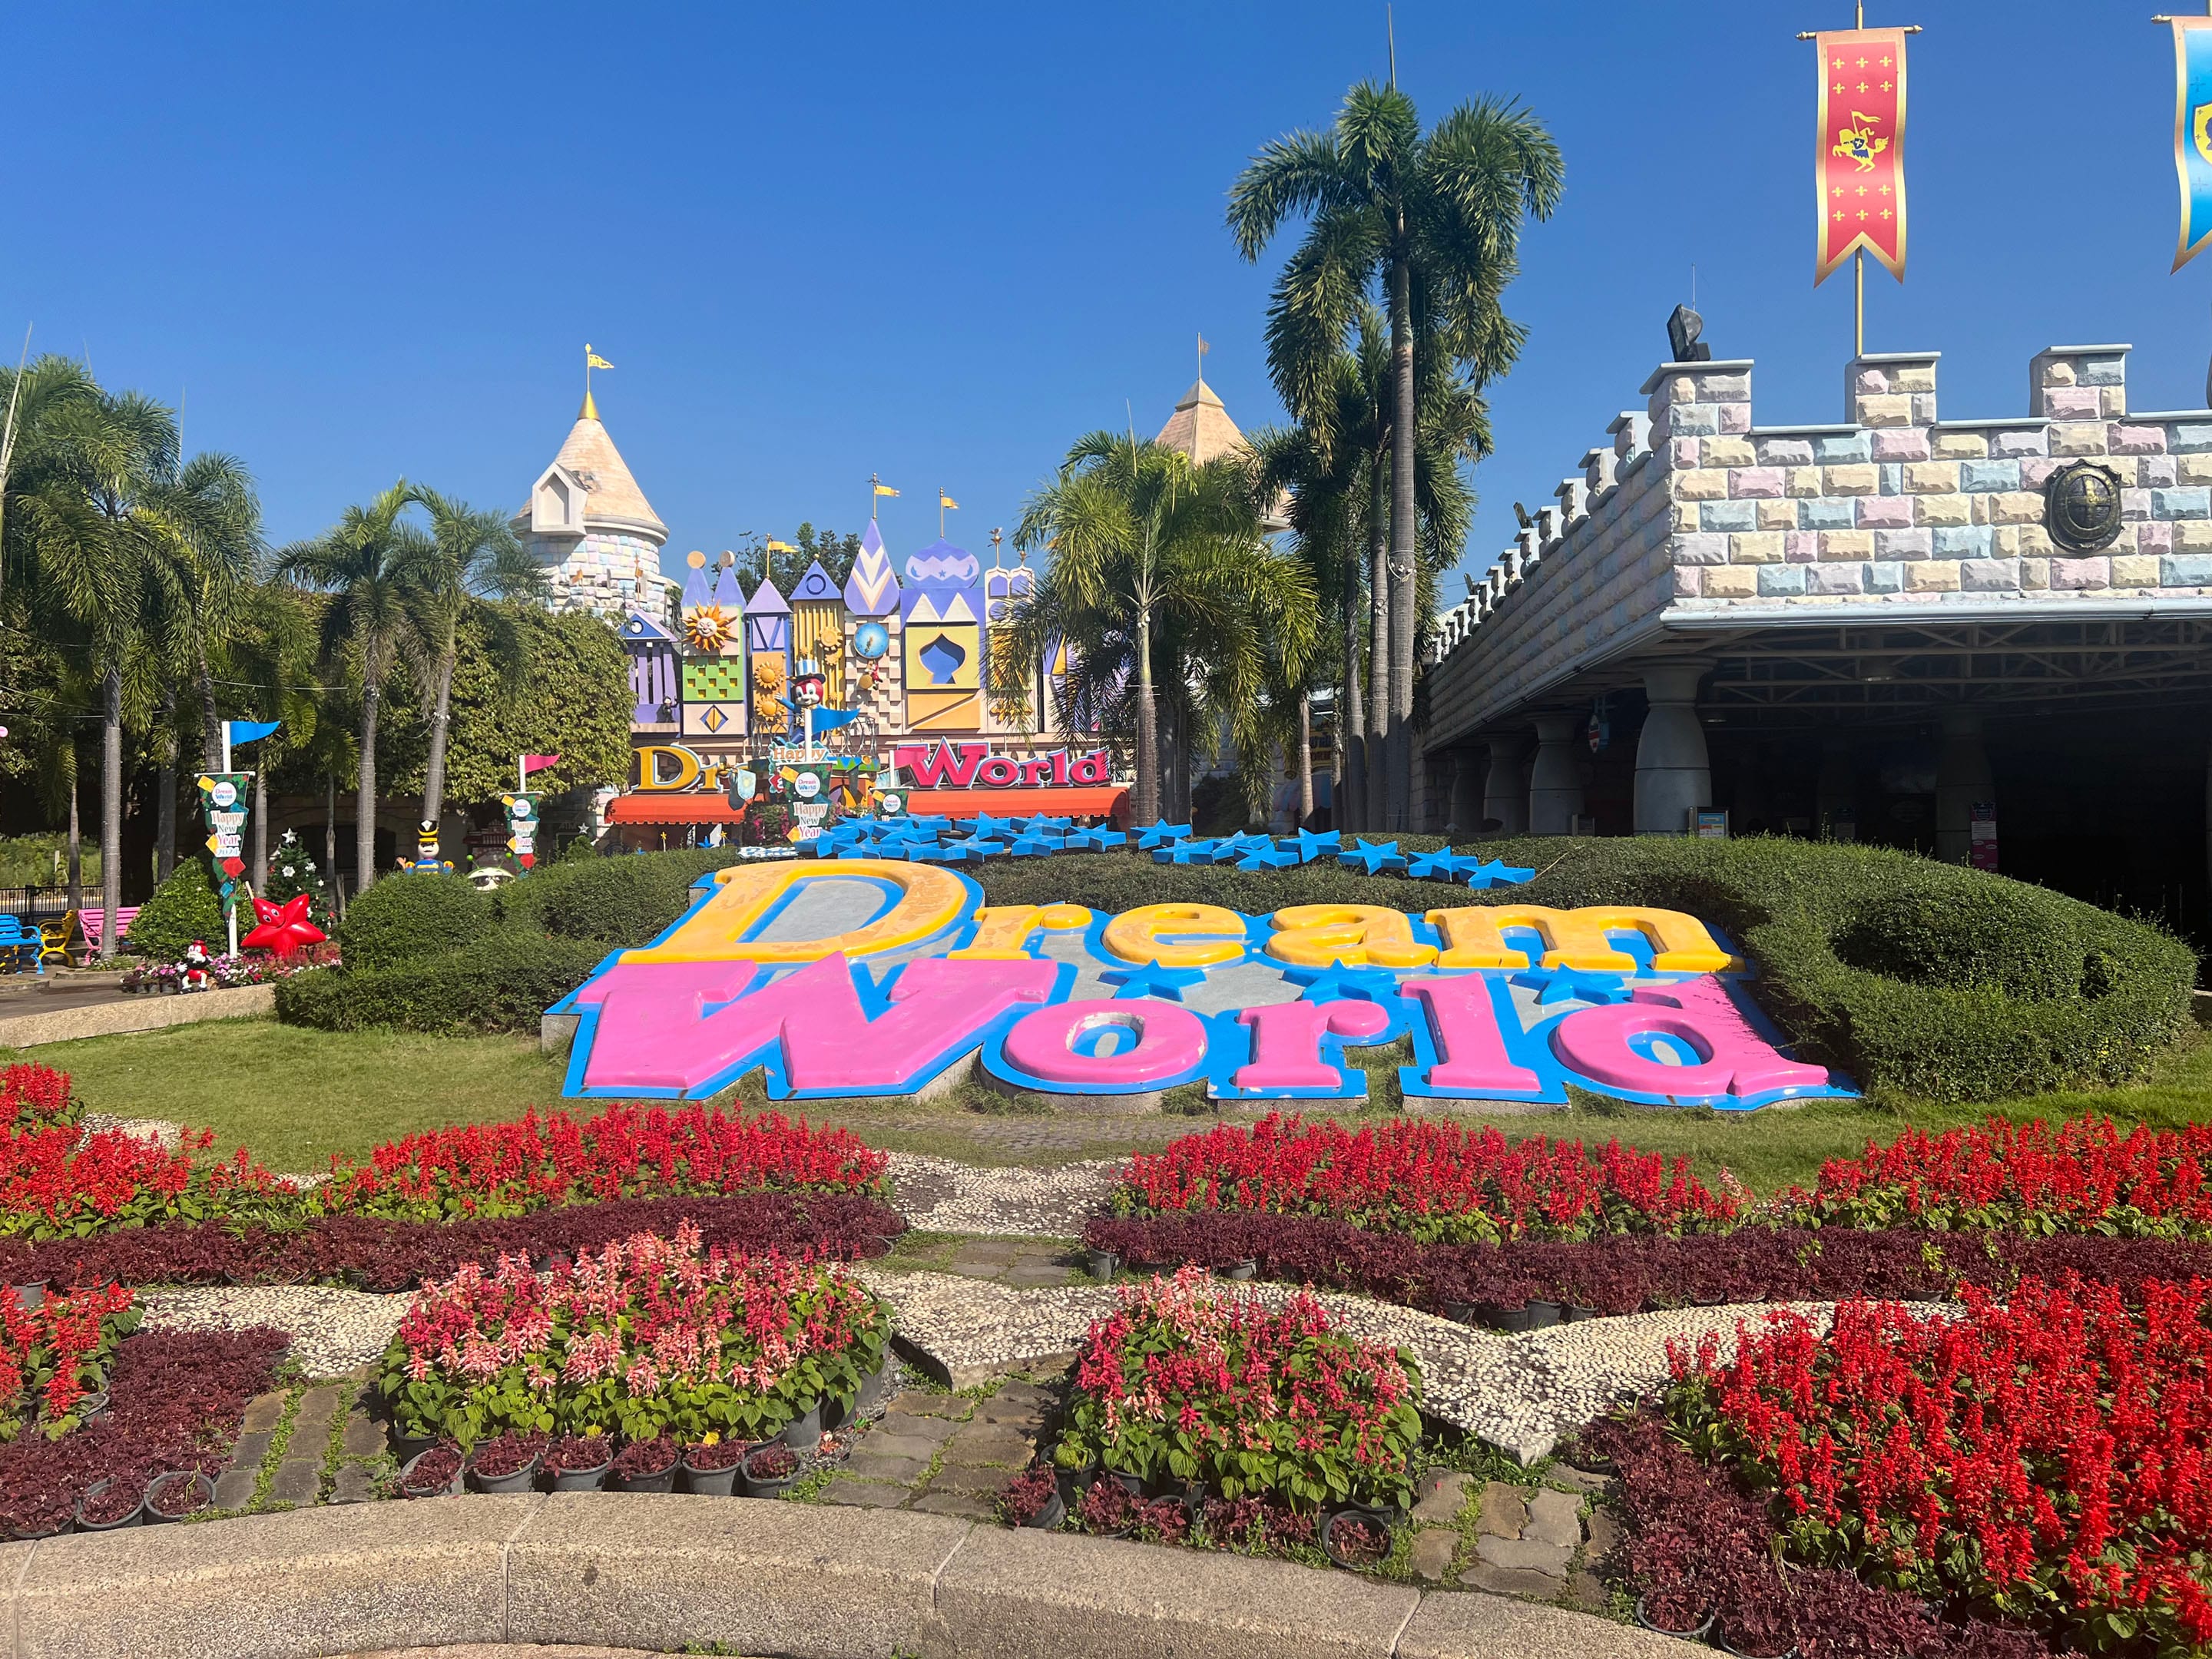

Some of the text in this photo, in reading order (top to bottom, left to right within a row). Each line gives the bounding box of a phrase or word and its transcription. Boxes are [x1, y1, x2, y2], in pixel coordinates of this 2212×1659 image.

[897, 735, 1111, 789] World
[795, 803, 827, 816] Happy
[213, 811, 243, 826] Happy
[800, 816, 819, 825] New
[218, 825, 236, 833] New
[512, 820, 535, 831] Happy
[799, 826, 820, 838] Year
[217, 834, 238, 846] Year
[515, 837, 531, 846] Year
[618, 859, 1747, 973] Dream
[575, 949, 1830, 1098] World
